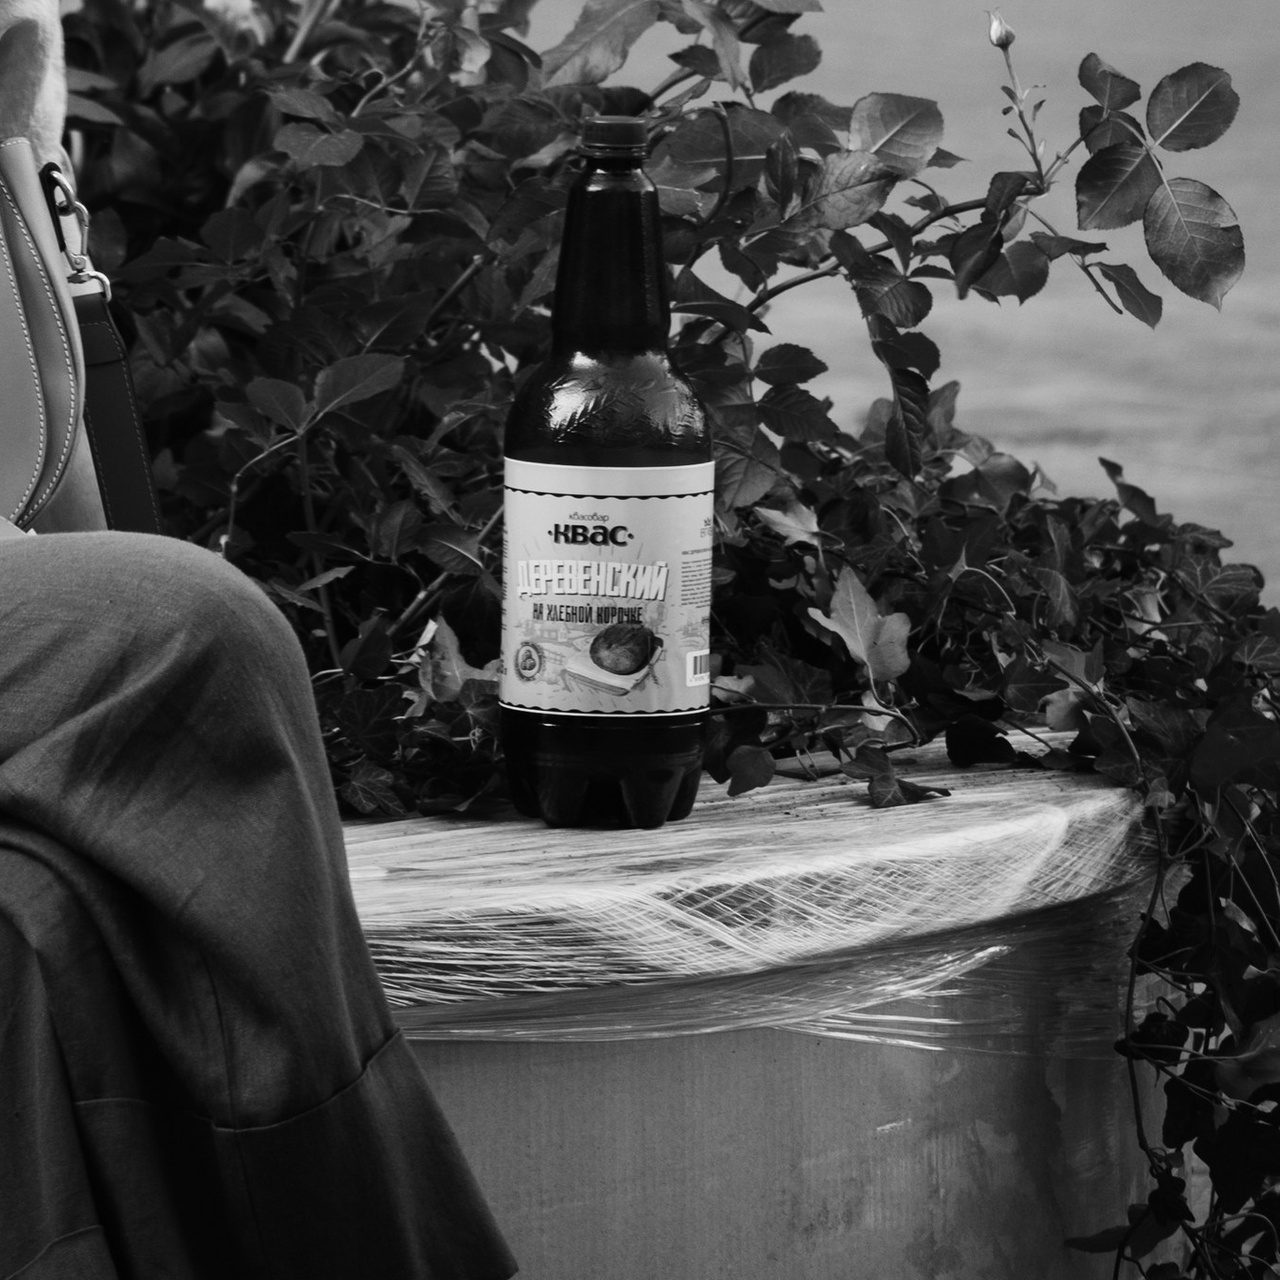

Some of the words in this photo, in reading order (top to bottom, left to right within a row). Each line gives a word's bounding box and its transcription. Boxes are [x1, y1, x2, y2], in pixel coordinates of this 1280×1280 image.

[517, 559, 669, 602] ДЕРЕВЕНСКИЙ
[532, 602, 544, 621] НА
[546, 603, 593, 624] ХЛЕБНОЙ
[596, 606, 644, 625] КОРОЧКЕ
